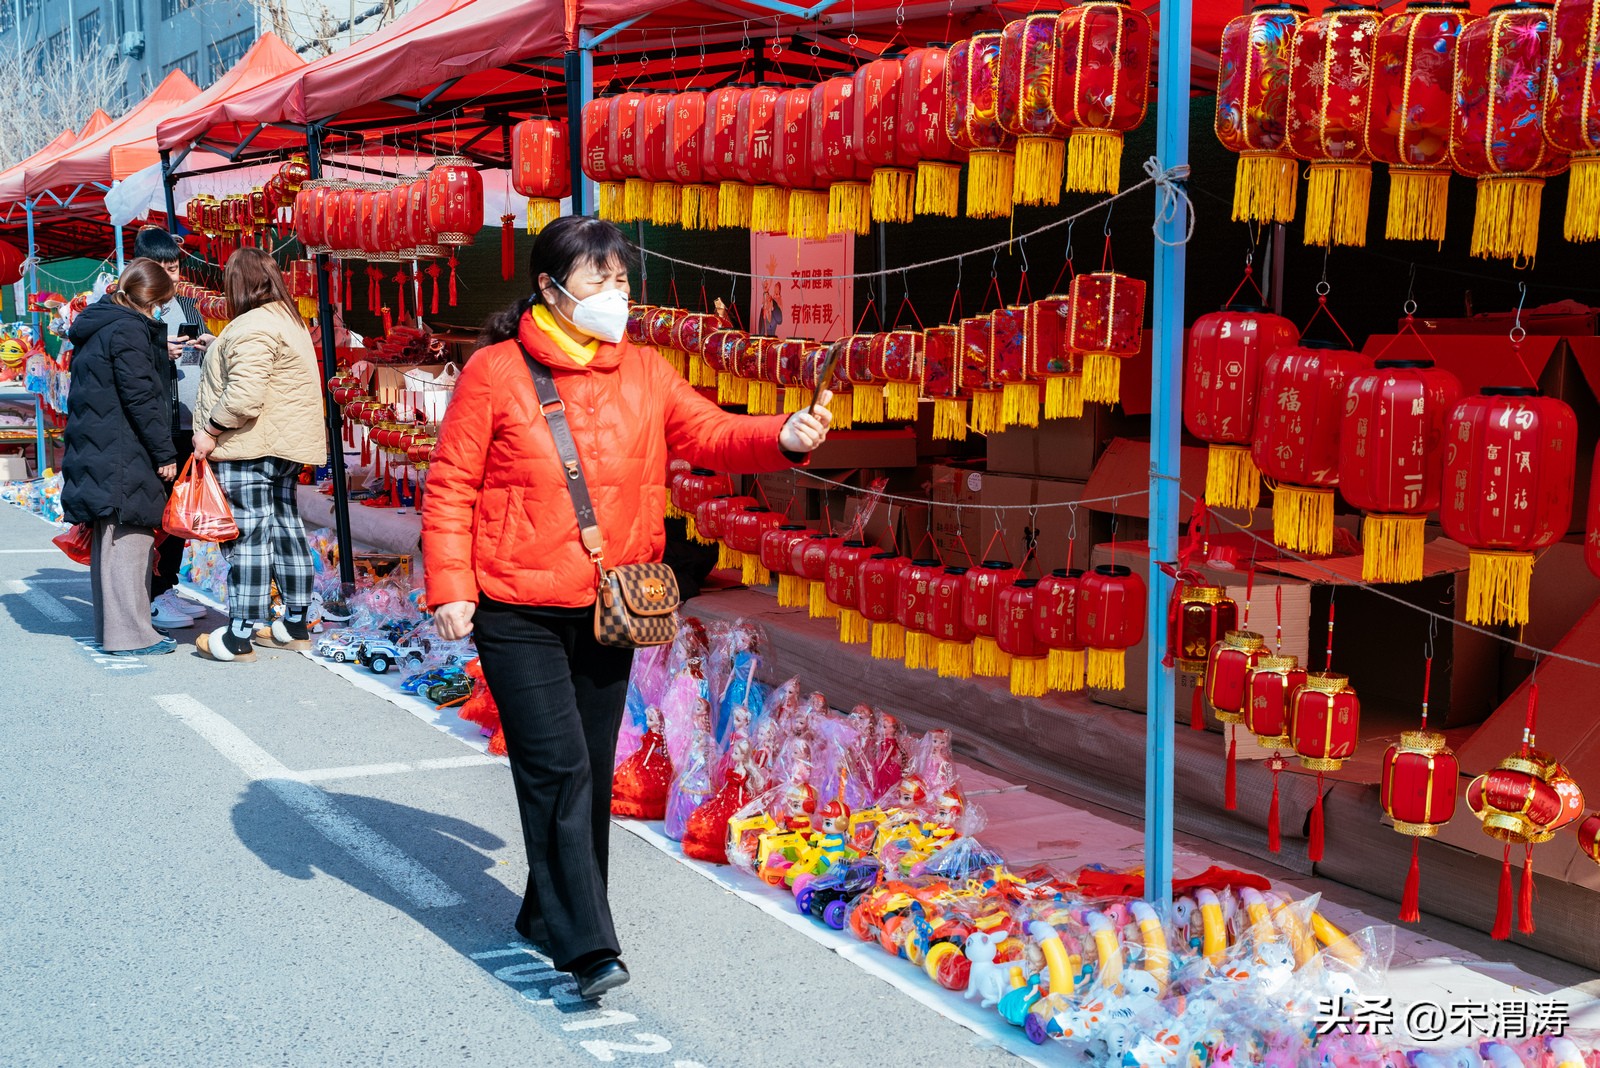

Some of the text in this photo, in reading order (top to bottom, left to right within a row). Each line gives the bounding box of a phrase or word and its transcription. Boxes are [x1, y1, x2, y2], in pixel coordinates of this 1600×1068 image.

[791, 268, 834, 290] 文明健康
[791, 304, 833, 325] 有你有我
[1277, 387, 1301, 412] 福
